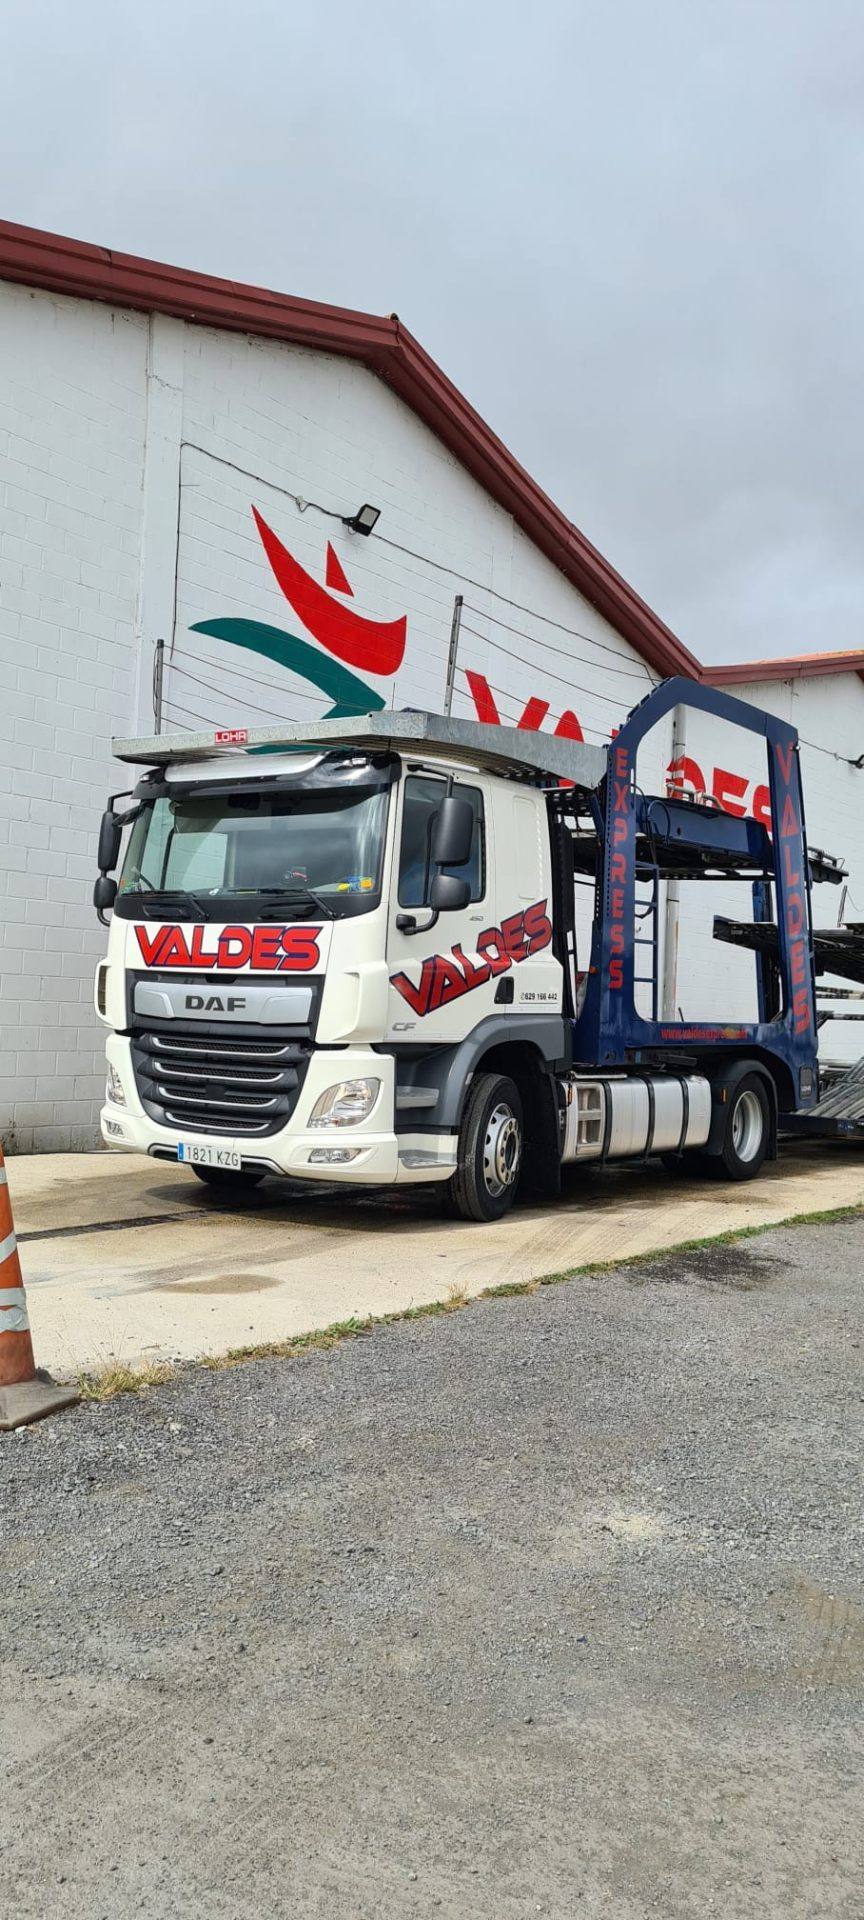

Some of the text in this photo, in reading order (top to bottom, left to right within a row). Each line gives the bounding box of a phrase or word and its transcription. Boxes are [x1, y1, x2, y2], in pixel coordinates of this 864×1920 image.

[215, 731, 246, 743] LOHR
[608, 747, 629, 990] EXPRESS
[776, 741, 811, 1035] VALDES
[134, 925, 324, 972] VALDES
[389, 899, 553, 1017] VALDES
[185, 995, 246, 1011] DAF
[392, 1022, 416, 1031] CF
[187, 1146, 239, 1167] 1821 KZG
